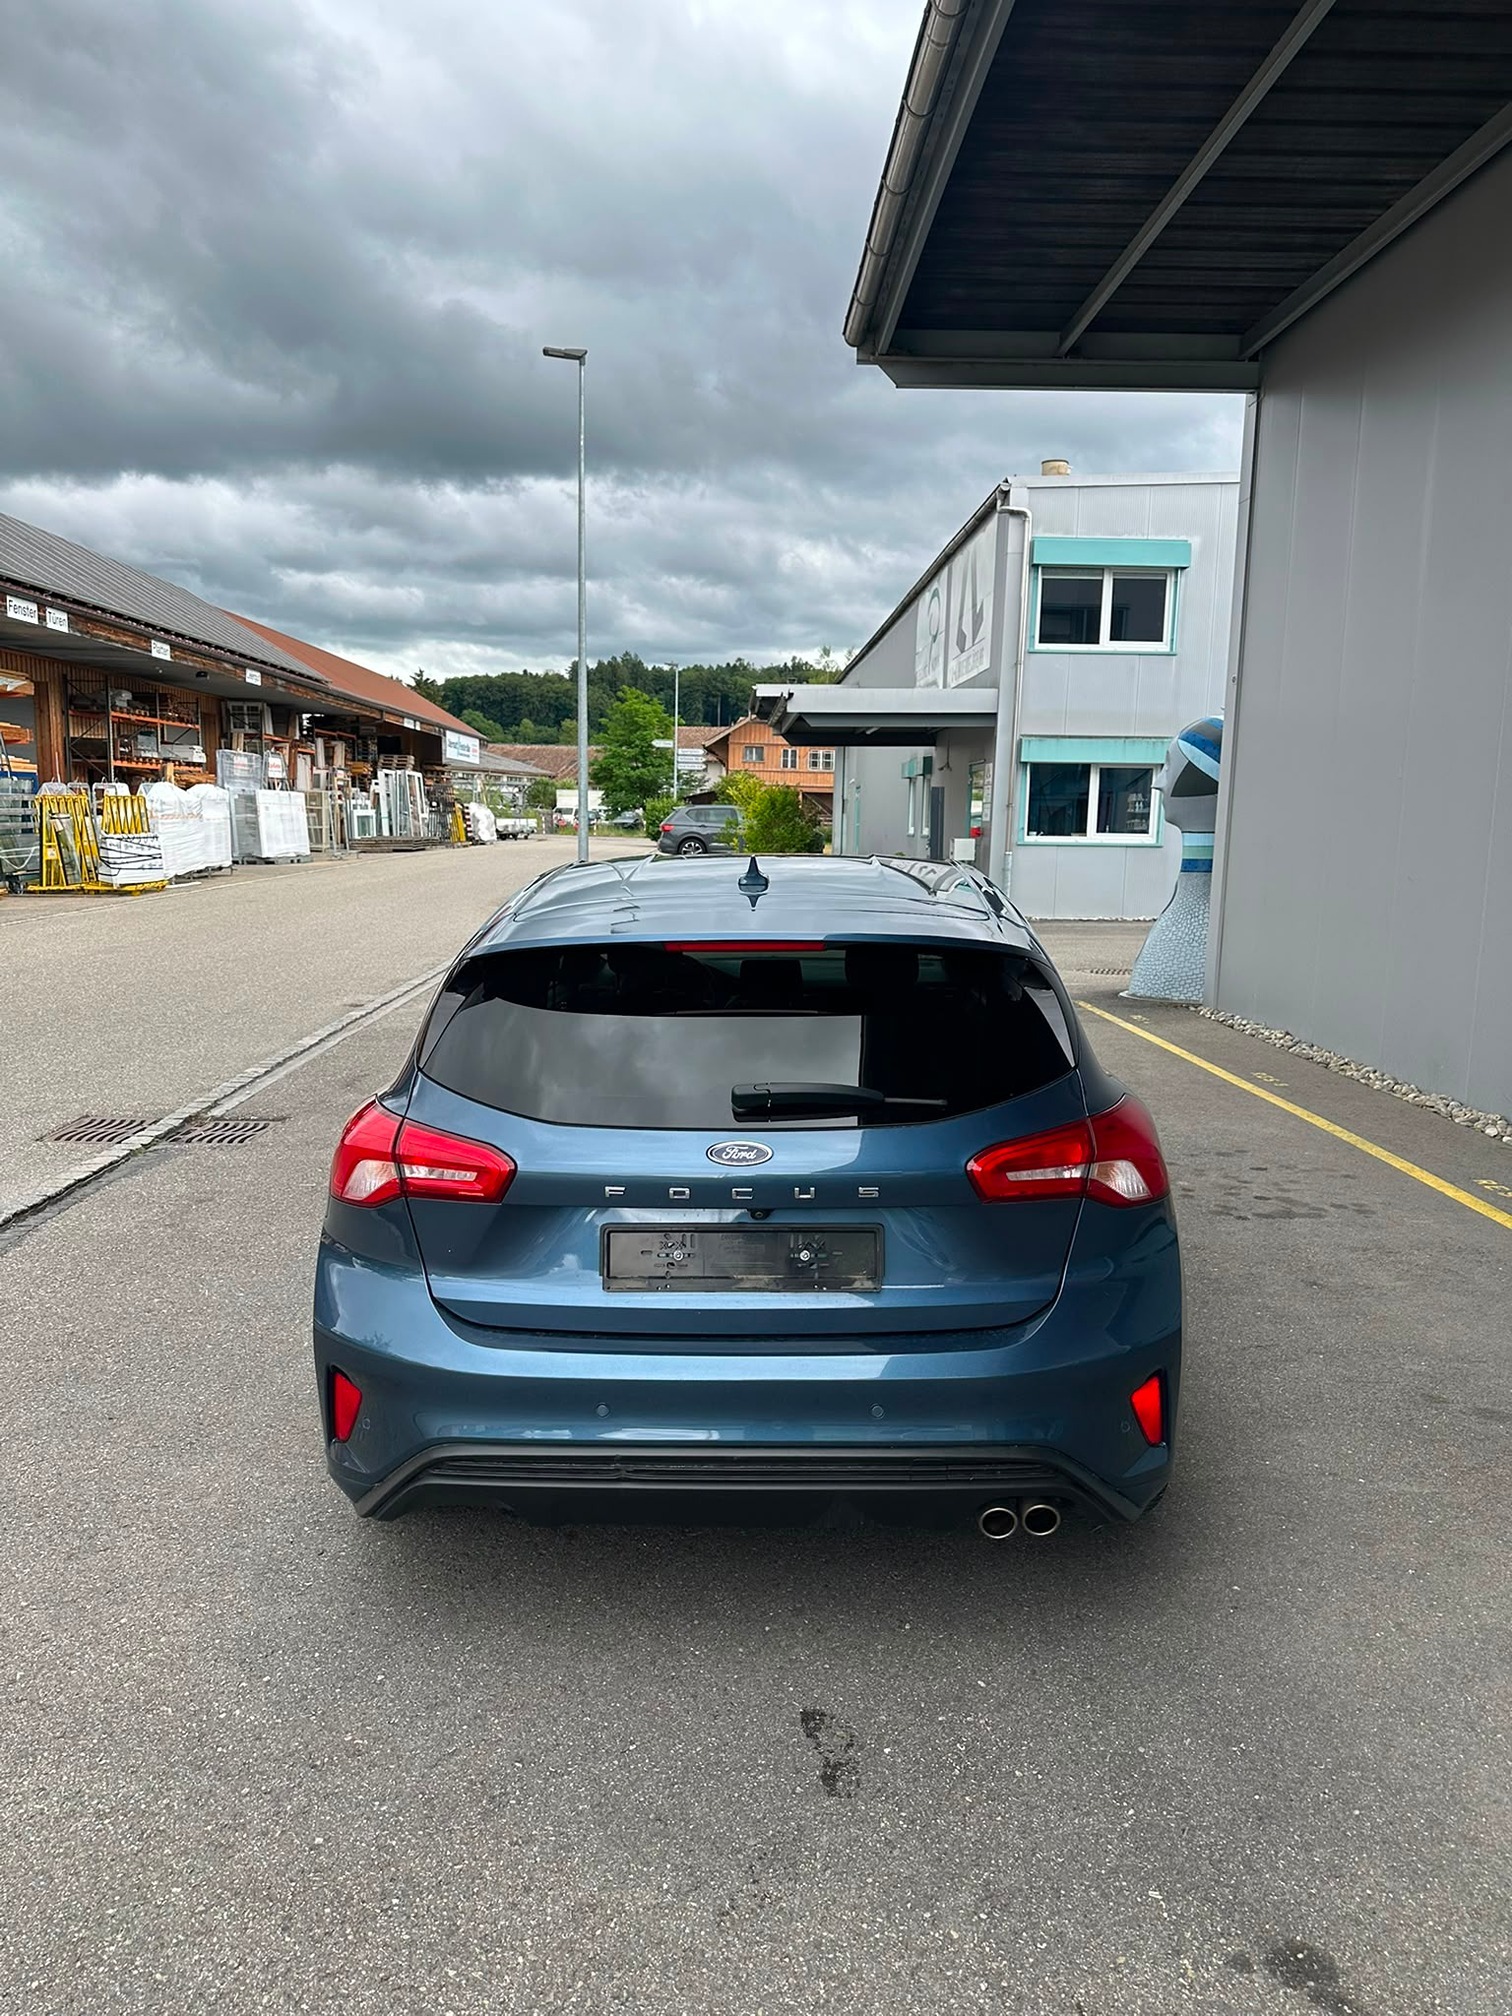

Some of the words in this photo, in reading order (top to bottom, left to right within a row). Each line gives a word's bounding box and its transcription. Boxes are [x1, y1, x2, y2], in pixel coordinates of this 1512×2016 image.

[8, 599, 37, 619] Fenster
[48, 610, 67, 627] Türen
[721, 1145, 758, 1161] Ford
[604, 1185, 879, 1200] FOCUS
